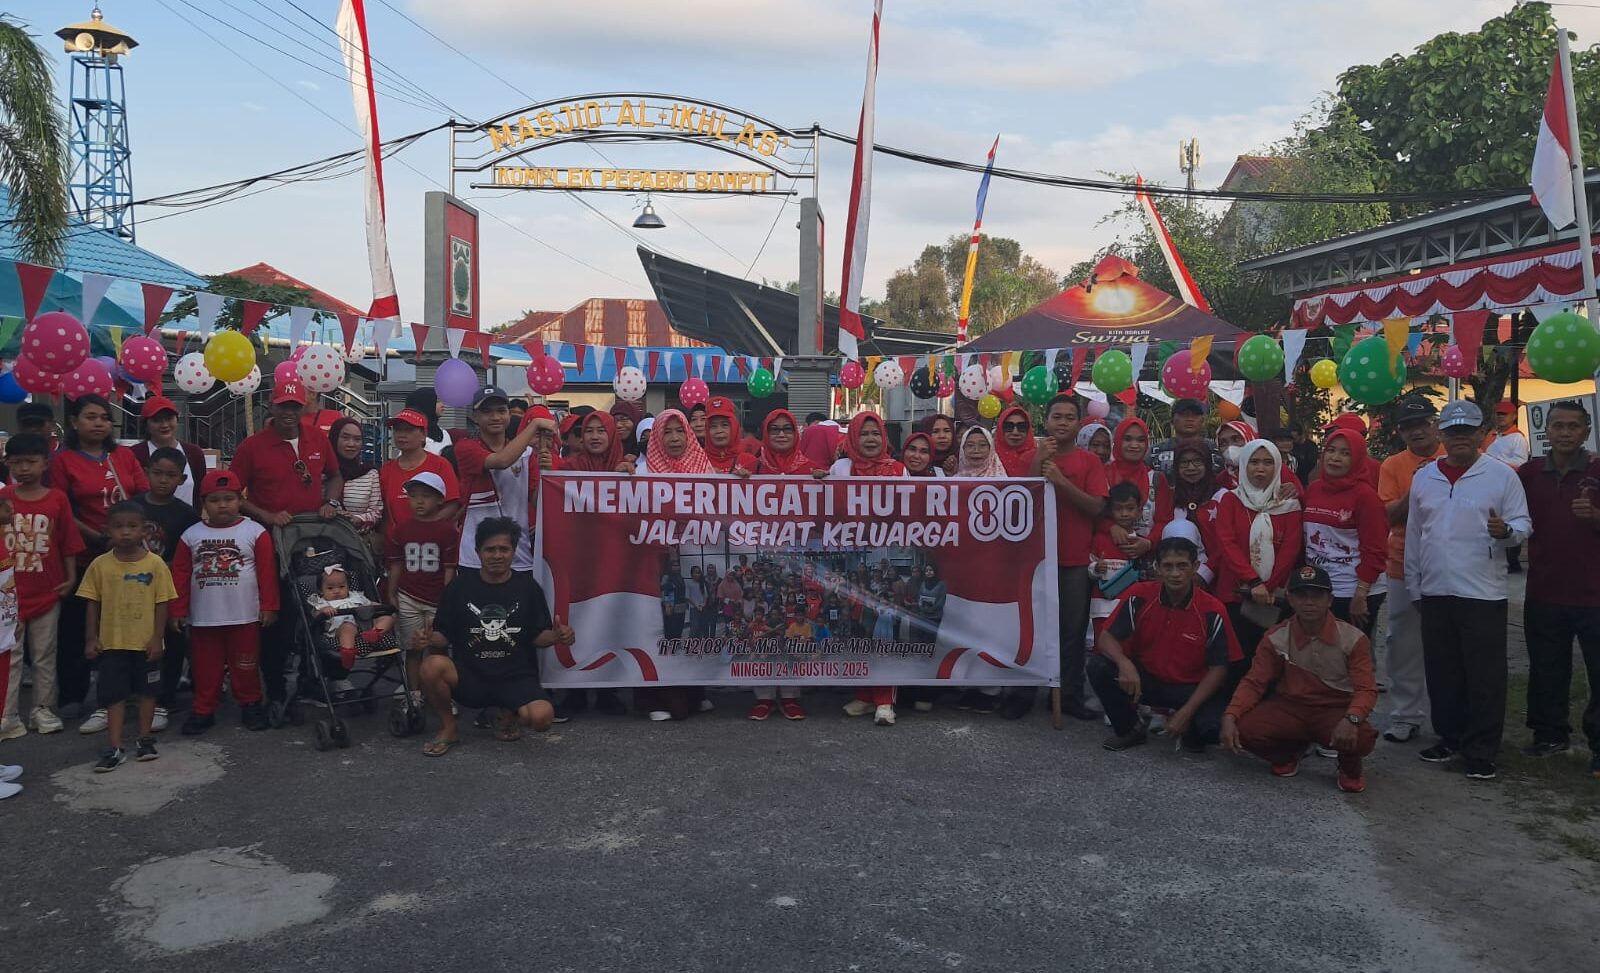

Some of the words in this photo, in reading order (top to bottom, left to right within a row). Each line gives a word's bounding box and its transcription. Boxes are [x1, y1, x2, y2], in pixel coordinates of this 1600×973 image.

[498, 167, 594, 187] KOMPLEK
[601, 170, 688, 190] PEPABRI
[695, 172, 771, 192] SAMPIT
[564, 481, 834, 516] MEMPERINGATI
[847, 484, 915, 516] HUT
[927, 485, 959, 516] RI
[967, 484, 1034, 542] 80
[630, 520, 722, 545] JALAN
[728, 521, 816, 546] SEHAT
[823, 522, 959, 547] KELUARGA
[658, 638, 681, 655] RT
[754, 638, 781, 654] MB.
[786, 637, 817, 655] Hulu
[847, 637, 872, 655] MB
[730, 662, 772, 677] MINGGU
[776, 662, 788, 677] 24
[792, 662, 838, 677] AGUSTUS
[842, 661, 869, 677] 2025
